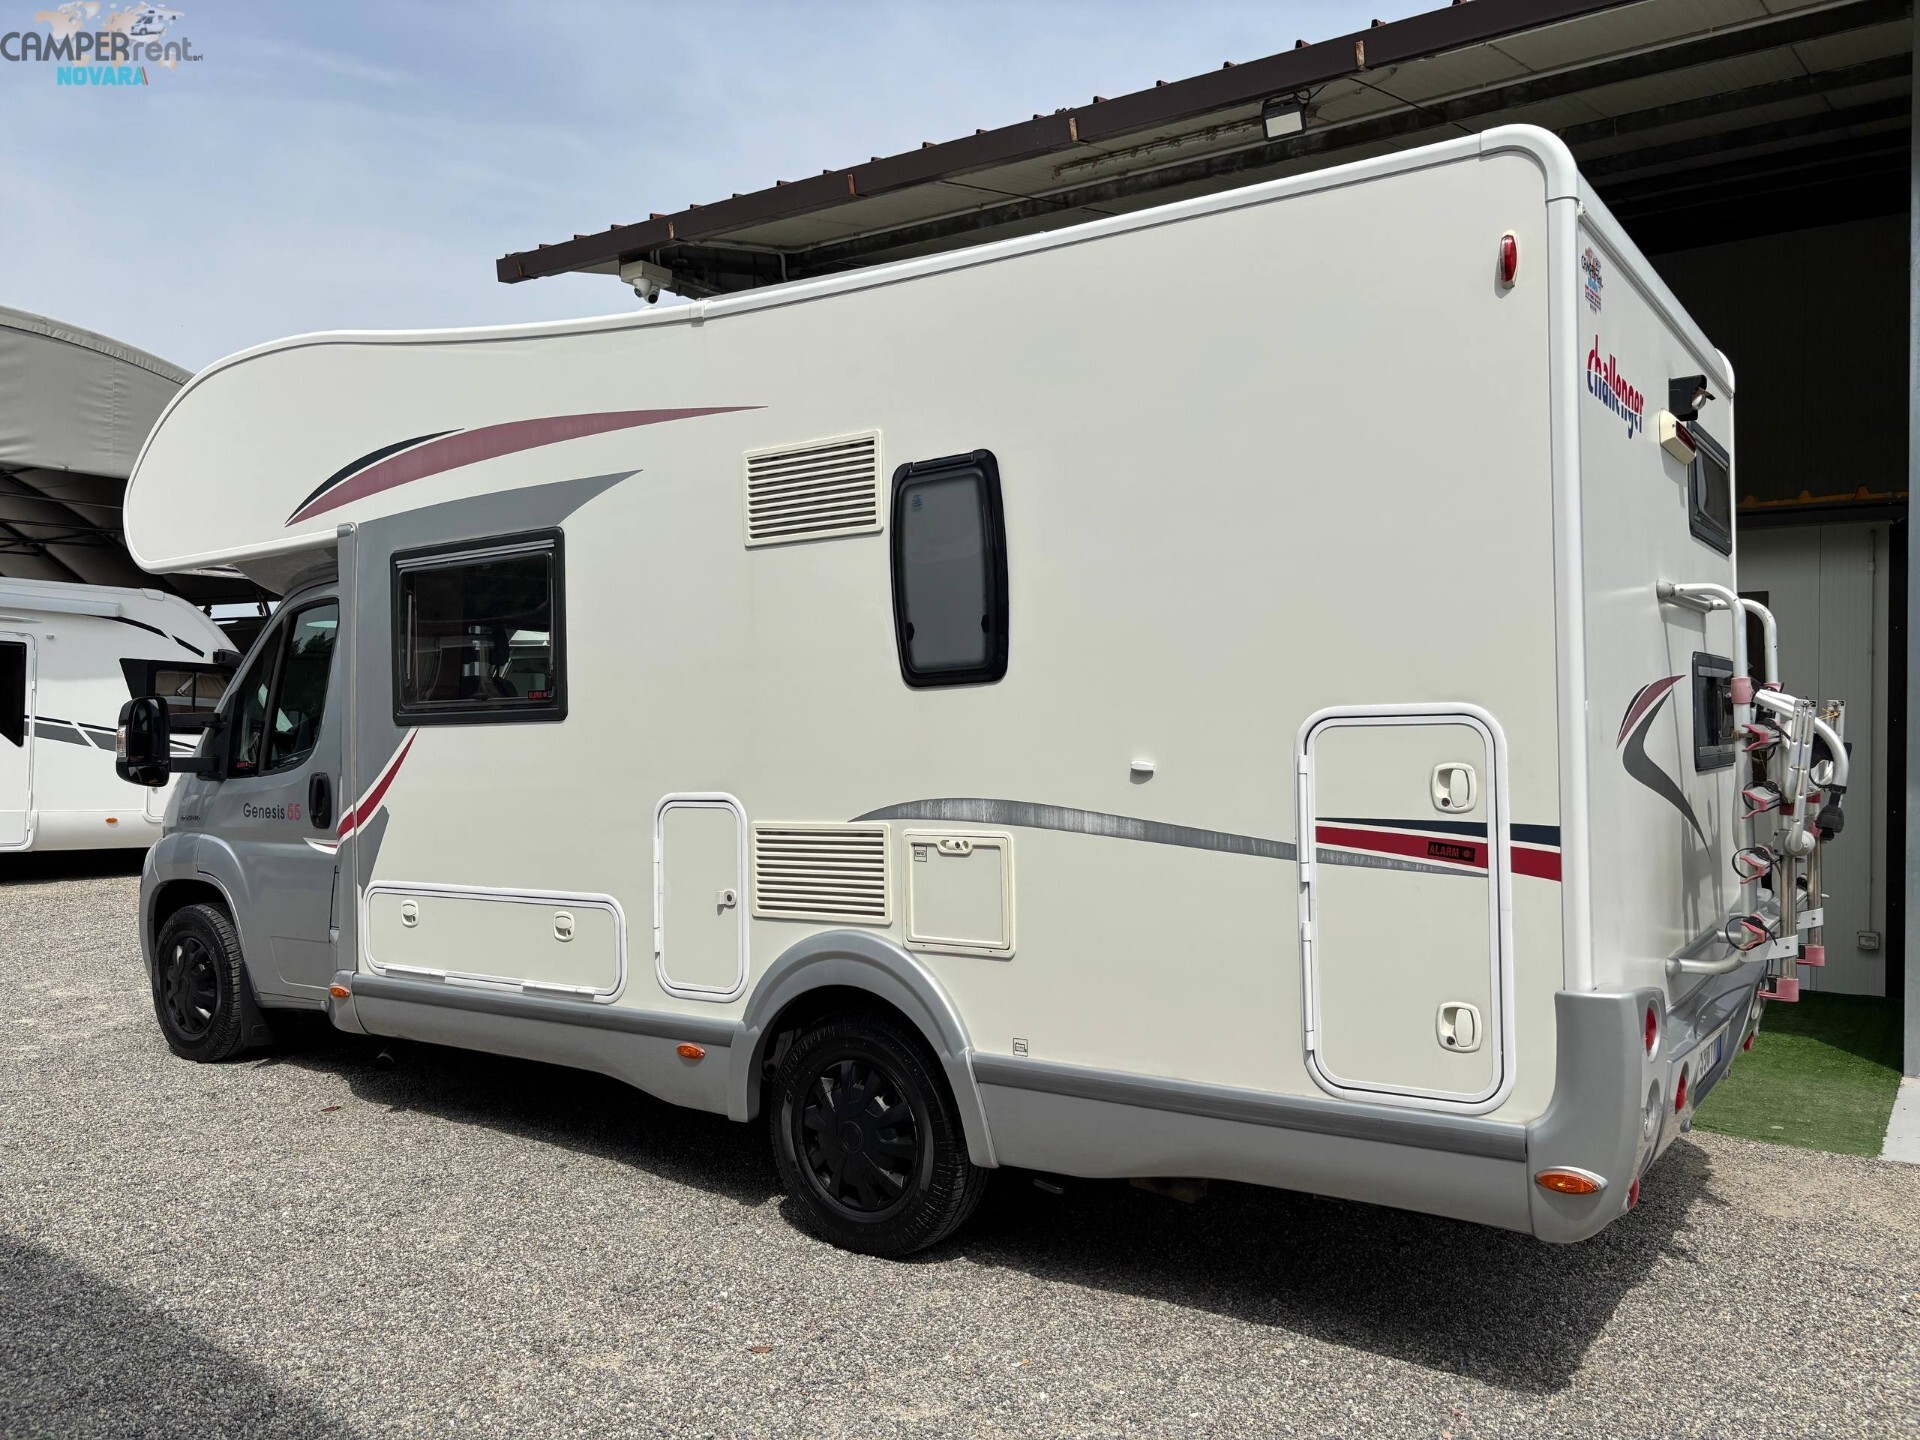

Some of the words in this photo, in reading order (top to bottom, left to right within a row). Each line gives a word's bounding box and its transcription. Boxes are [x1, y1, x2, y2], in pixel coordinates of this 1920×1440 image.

[1586, 334, 1645, 440] challenger
[243, 802, 285, 820] Genesis
[1429, 844, 1459, 857] ALARM
